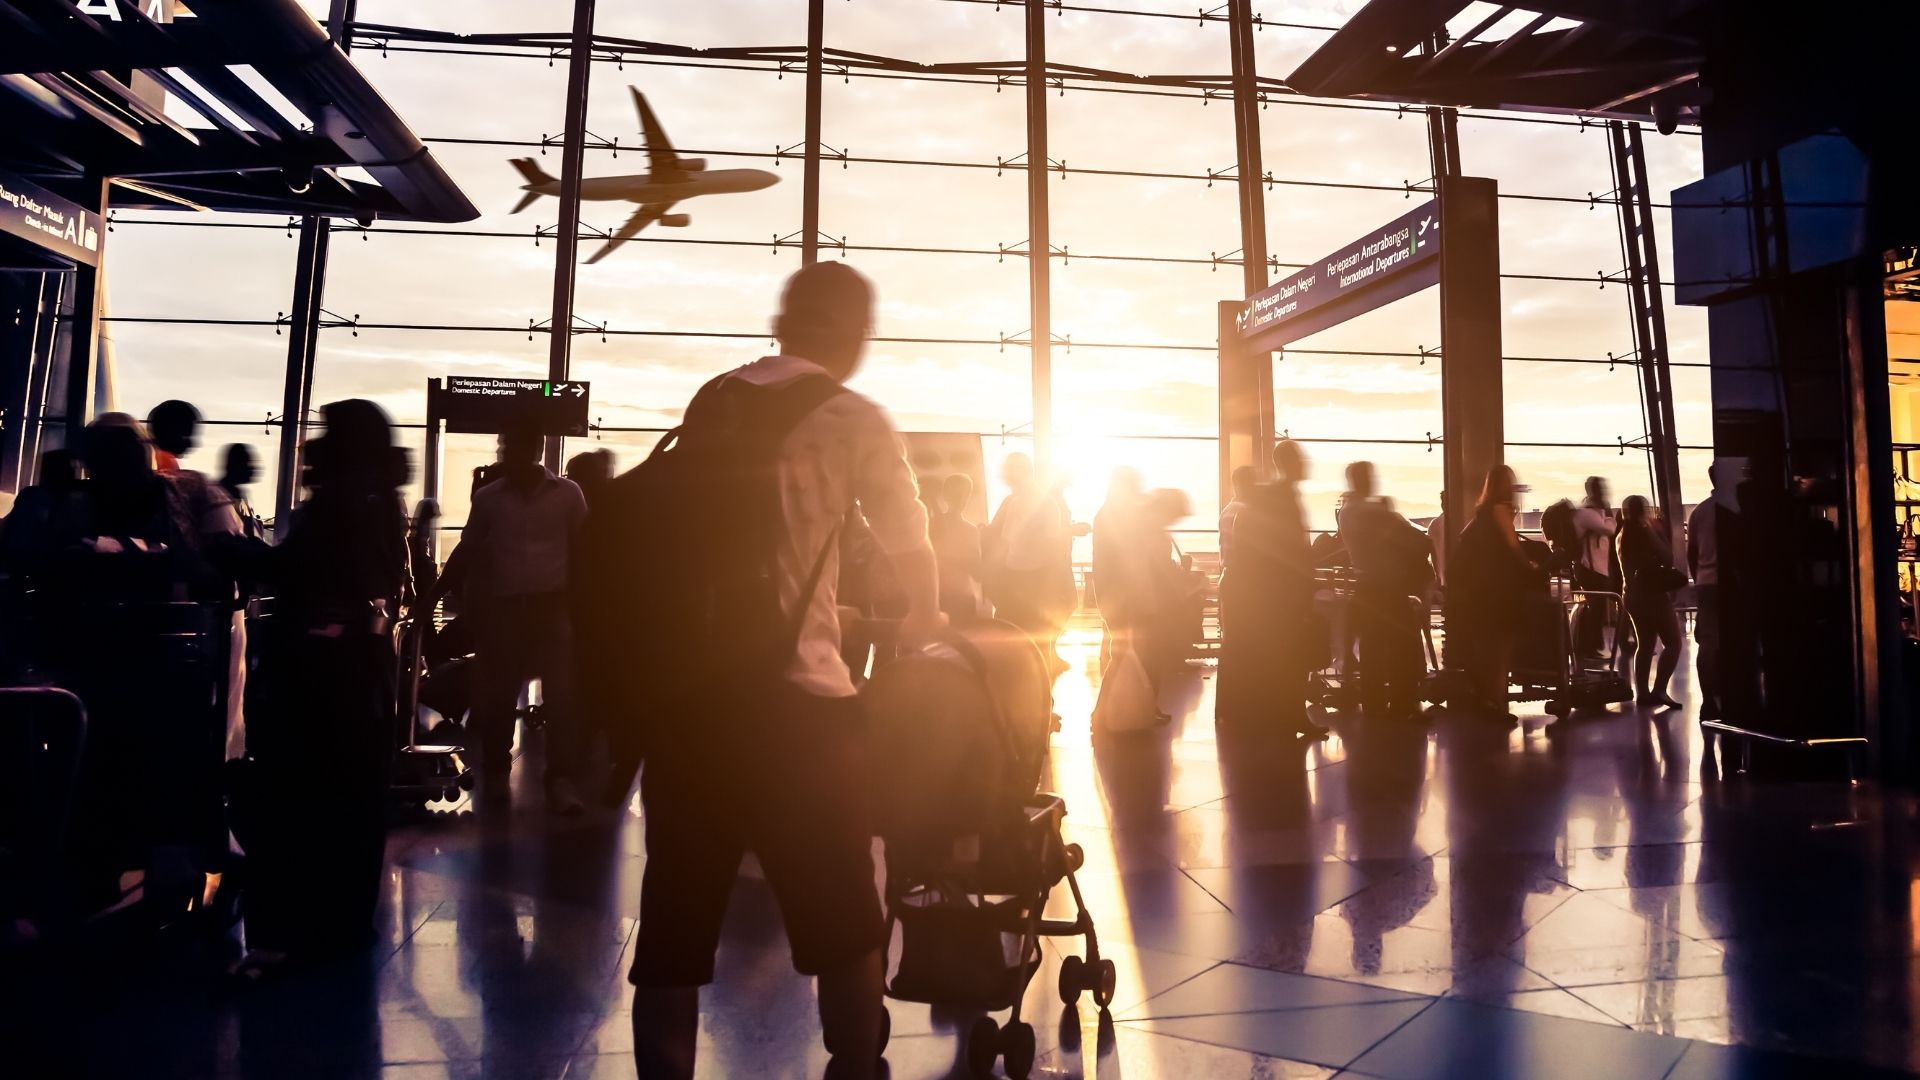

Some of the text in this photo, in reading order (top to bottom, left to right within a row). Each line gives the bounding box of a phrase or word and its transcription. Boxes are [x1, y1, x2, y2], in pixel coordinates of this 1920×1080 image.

[20, 194, 43, 214] Daftar
[64, 217, 77, 245] A
[1327, 227, 1409, 277] Perlepasan Antarabangsa
[1340, 247, 1410, 289] International Departures
[1255, 271, 1316, 312] Perlepasan Dalam Negeri
[452, 379, 542, 390] Perlepasan Dalam Negeri
[481, 388, 516, 396] Departures
